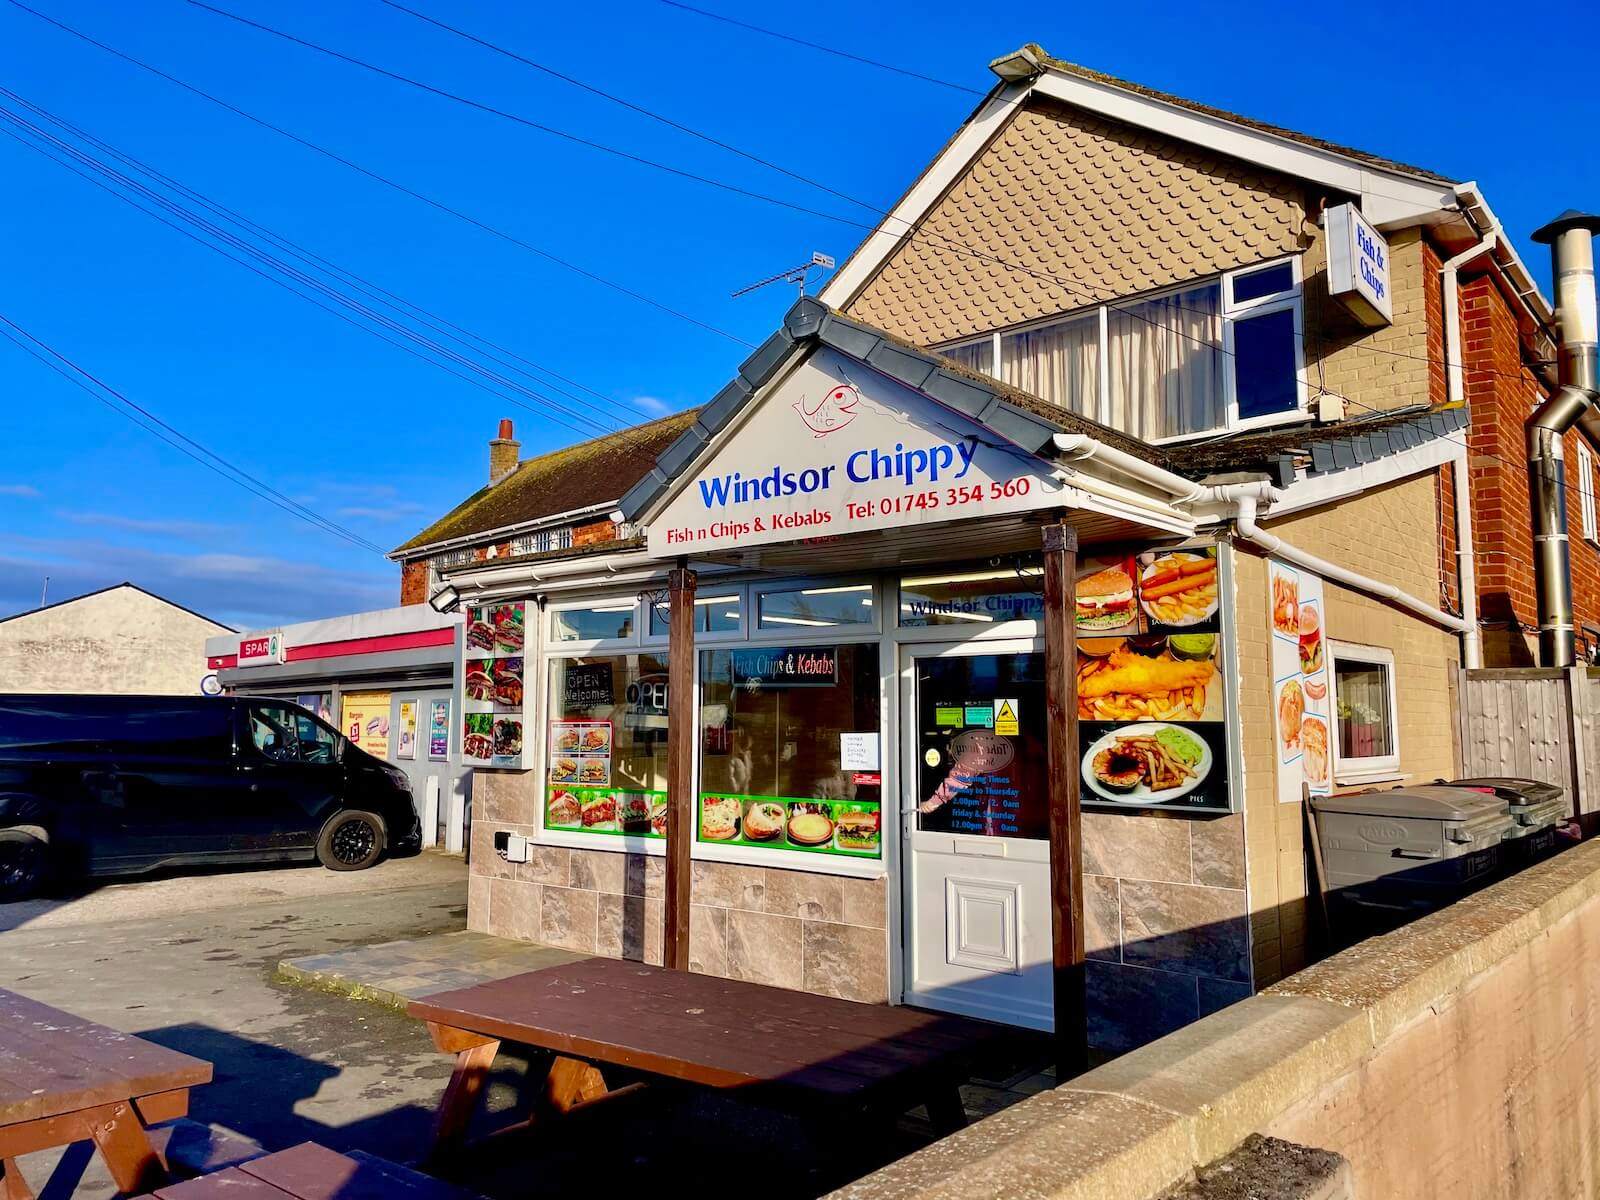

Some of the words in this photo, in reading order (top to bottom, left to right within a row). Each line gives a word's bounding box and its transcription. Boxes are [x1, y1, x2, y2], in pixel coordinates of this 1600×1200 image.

[1356, 223, 1375, 263] Fish
[1376, 247, 1384, 272] &
[1360, 256, 1385, 300] Chips
[699, 465, 835, 509] Windsor
[846, 440, 978, 486] Chippy
[667, 527, 693, 544] Fish
[697, 527, 707, 540] n
[710, 520, 750, 540] Chips
[754, 516, 766, 532] &
[772, 508, 832, 530] Kebabs
[846, 500, 875, 520] Tel:
[880, 490, 940, 515] 01745
[945, 484, 984, 506] 354
[990, 477, 1030, 501] 560
[910, 600, 980, 616] Windsor
[985, 594, 1044, 614] Chippy
[245, 641, 269, 655] SPAR
[735, 655, 754, 677] Fish
[756, 655, 784, 679] Chips
[785, 653, 795, 674] &
[797, 653, 834, 674] Kebabs
[568, 674, 600, 688] OPEN
[564, 690, 605, 700] Welcome
[989, 775, 1009, 784] Times
[986, 788, 1020, 797] Thursday
[952, 808, 974, 817] Friday
